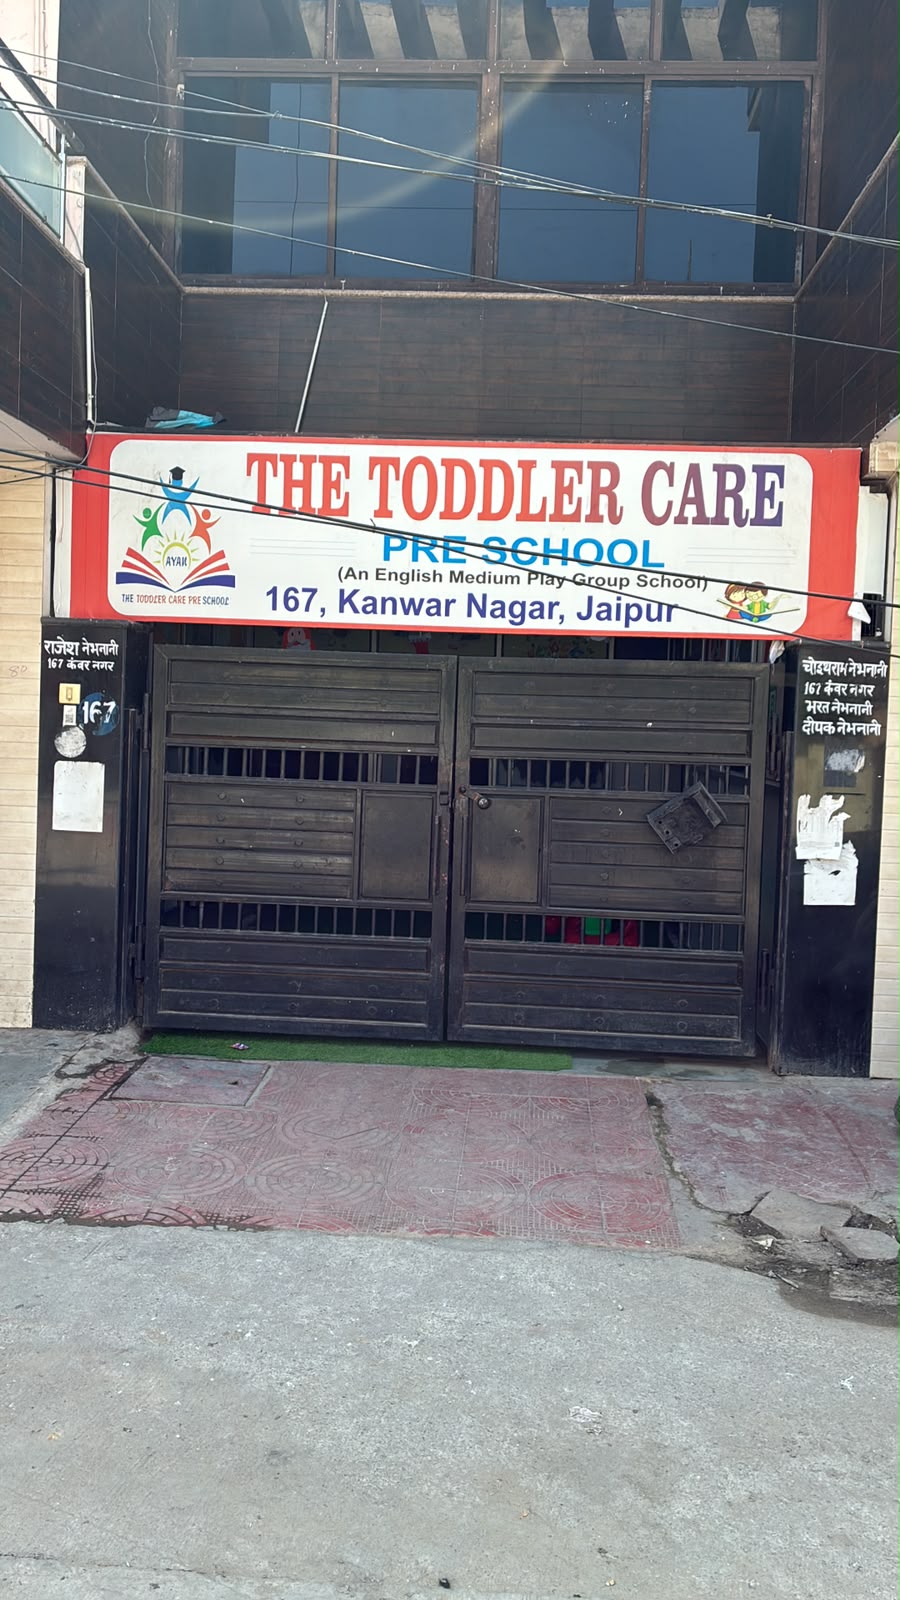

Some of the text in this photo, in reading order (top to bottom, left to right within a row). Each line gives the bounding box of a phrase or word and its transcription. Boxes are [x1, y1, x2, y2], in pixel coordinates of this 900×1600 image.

[246, 453, 785, 527] THE TODDLER CARE
[383, 534, 665, 568] PRE SCHOOL
[338, 567, 708, 592] (An English Medium Play Group School)
[122, 593, 134, 603] THE
[168, 595, 186, 604] CARE
[188, 596, 201, 605] PRE
[266, 586, 679, 628] 167, Kanwar Nagar, Jaipur
[48, 657, 115, 672] 167 कंवर नगर
[804, 682, 821, 695] 167
[82, 700, 116, 724] 167
[805, 700, 830, 714] भरत
[802, 716, 835, 735] दीपक
